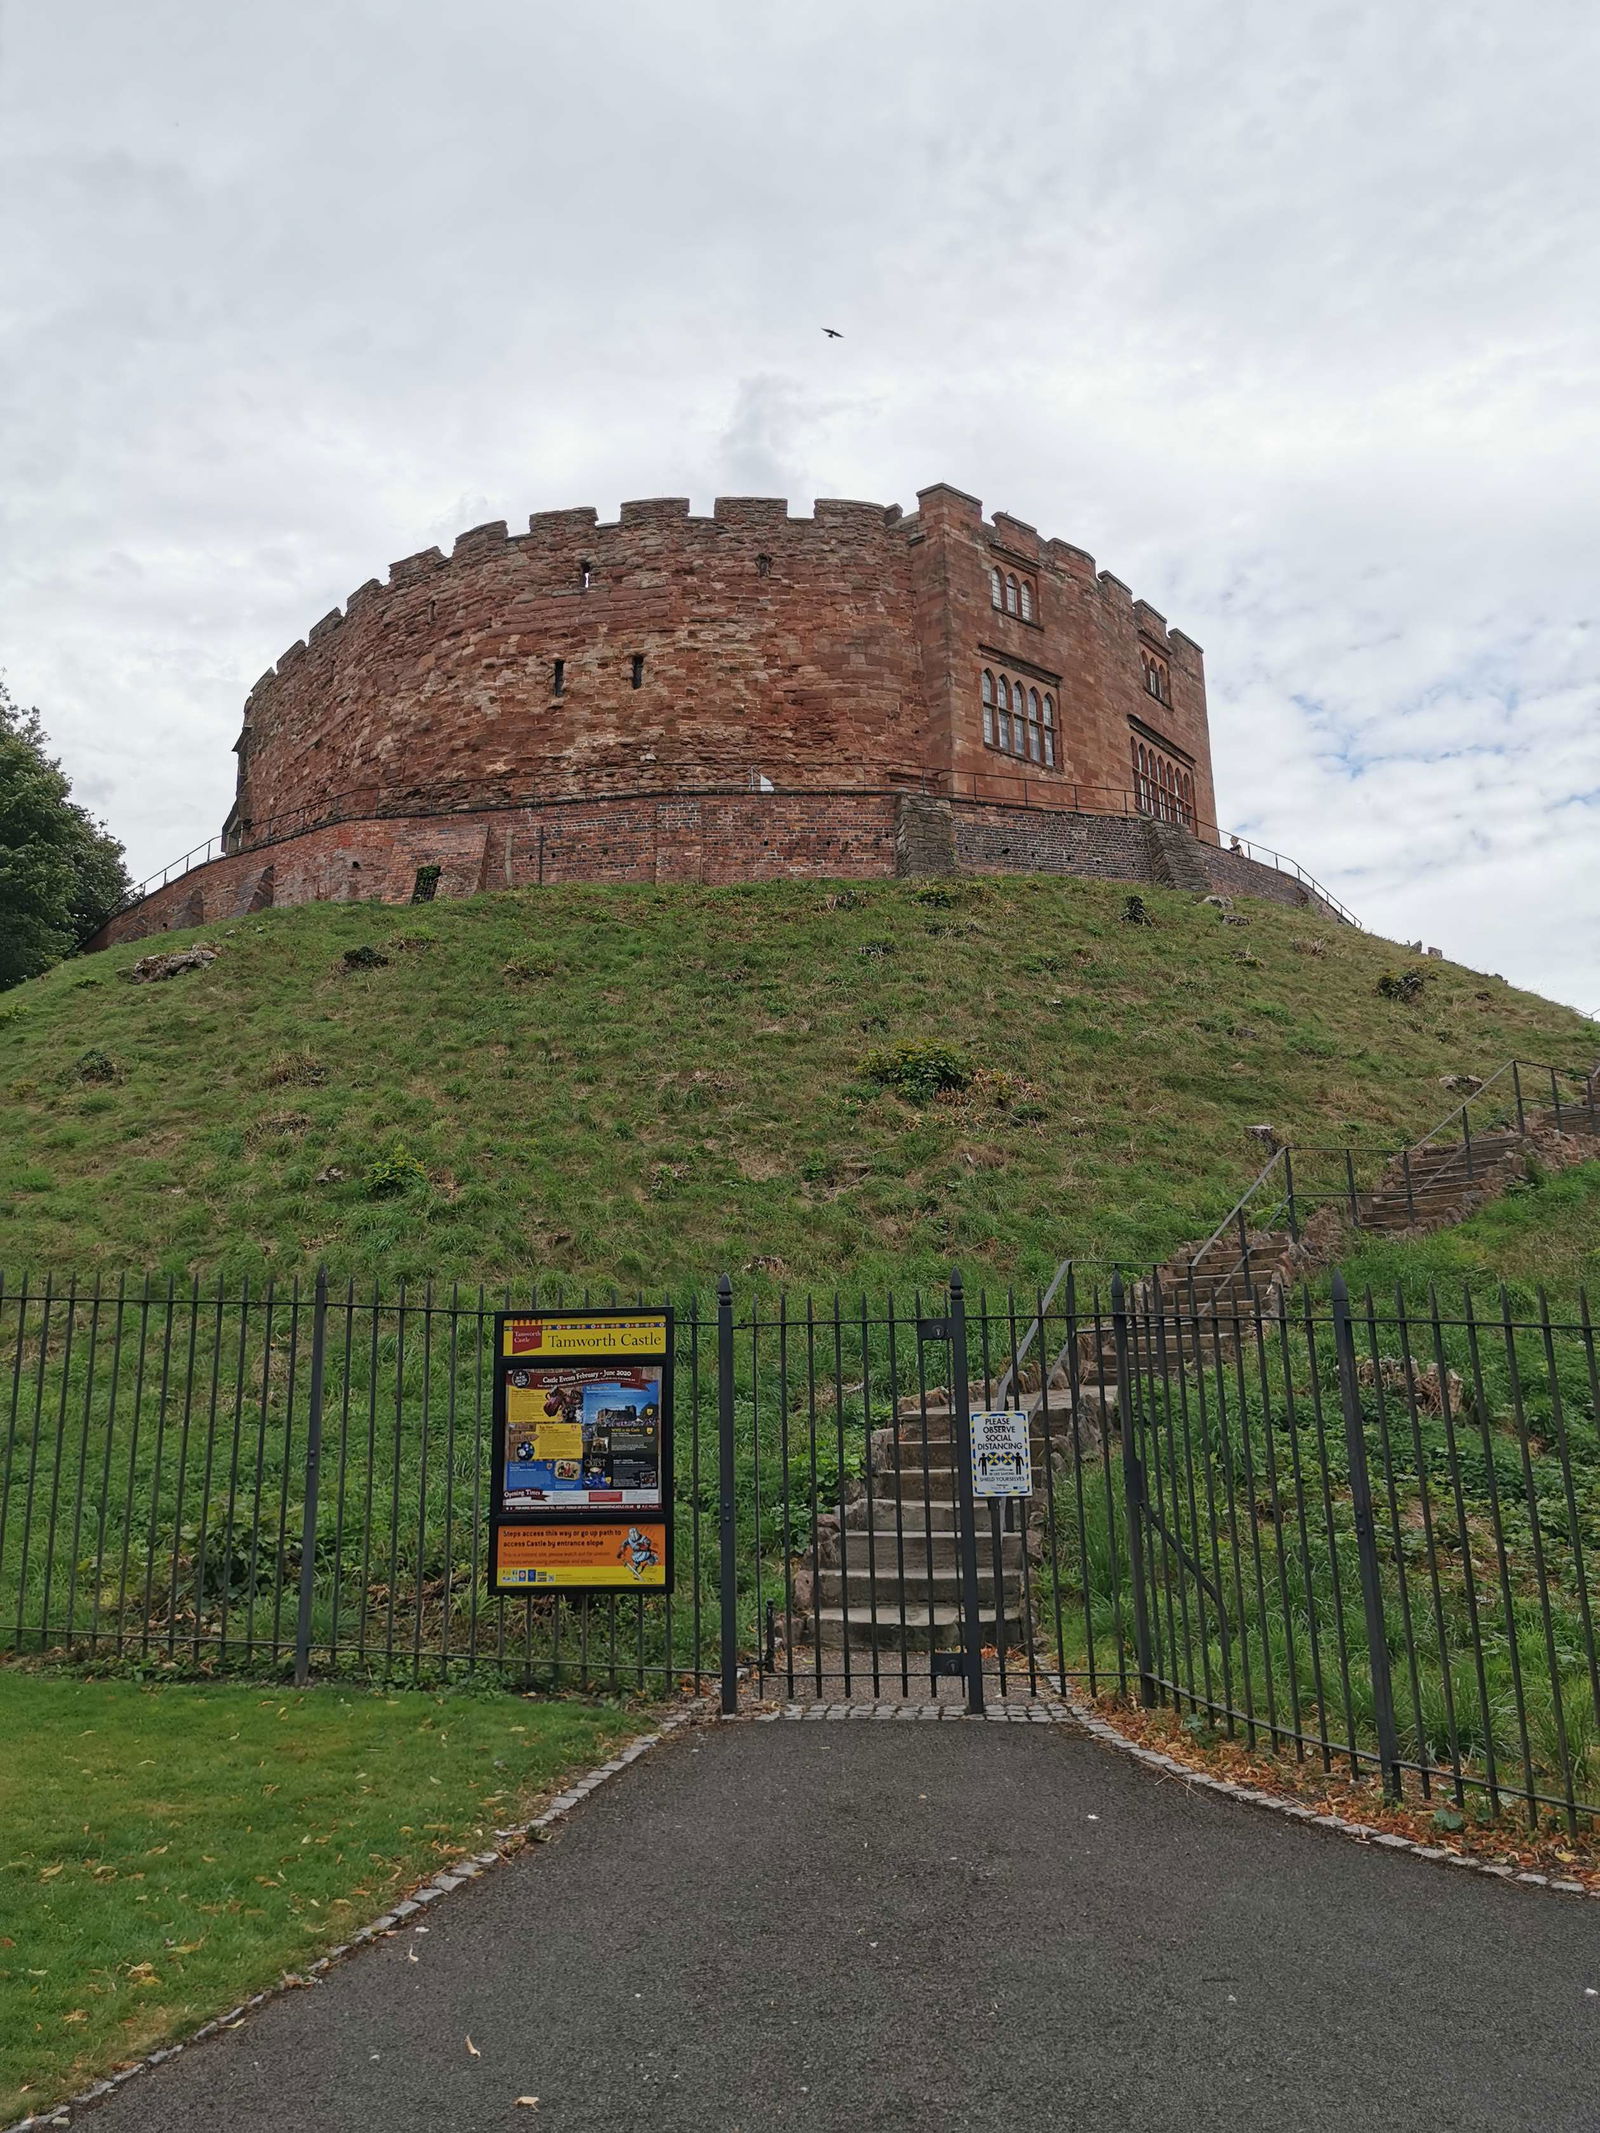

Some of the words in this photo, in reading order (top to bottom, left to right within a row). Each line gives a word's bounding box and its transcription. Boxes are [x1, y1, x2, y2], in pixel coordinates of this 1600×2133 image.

[548, 1334, 616, 1348] Tamworth
[620, 1332, 661, 1346] Castle
[576, 1371, 599, 1380] February
